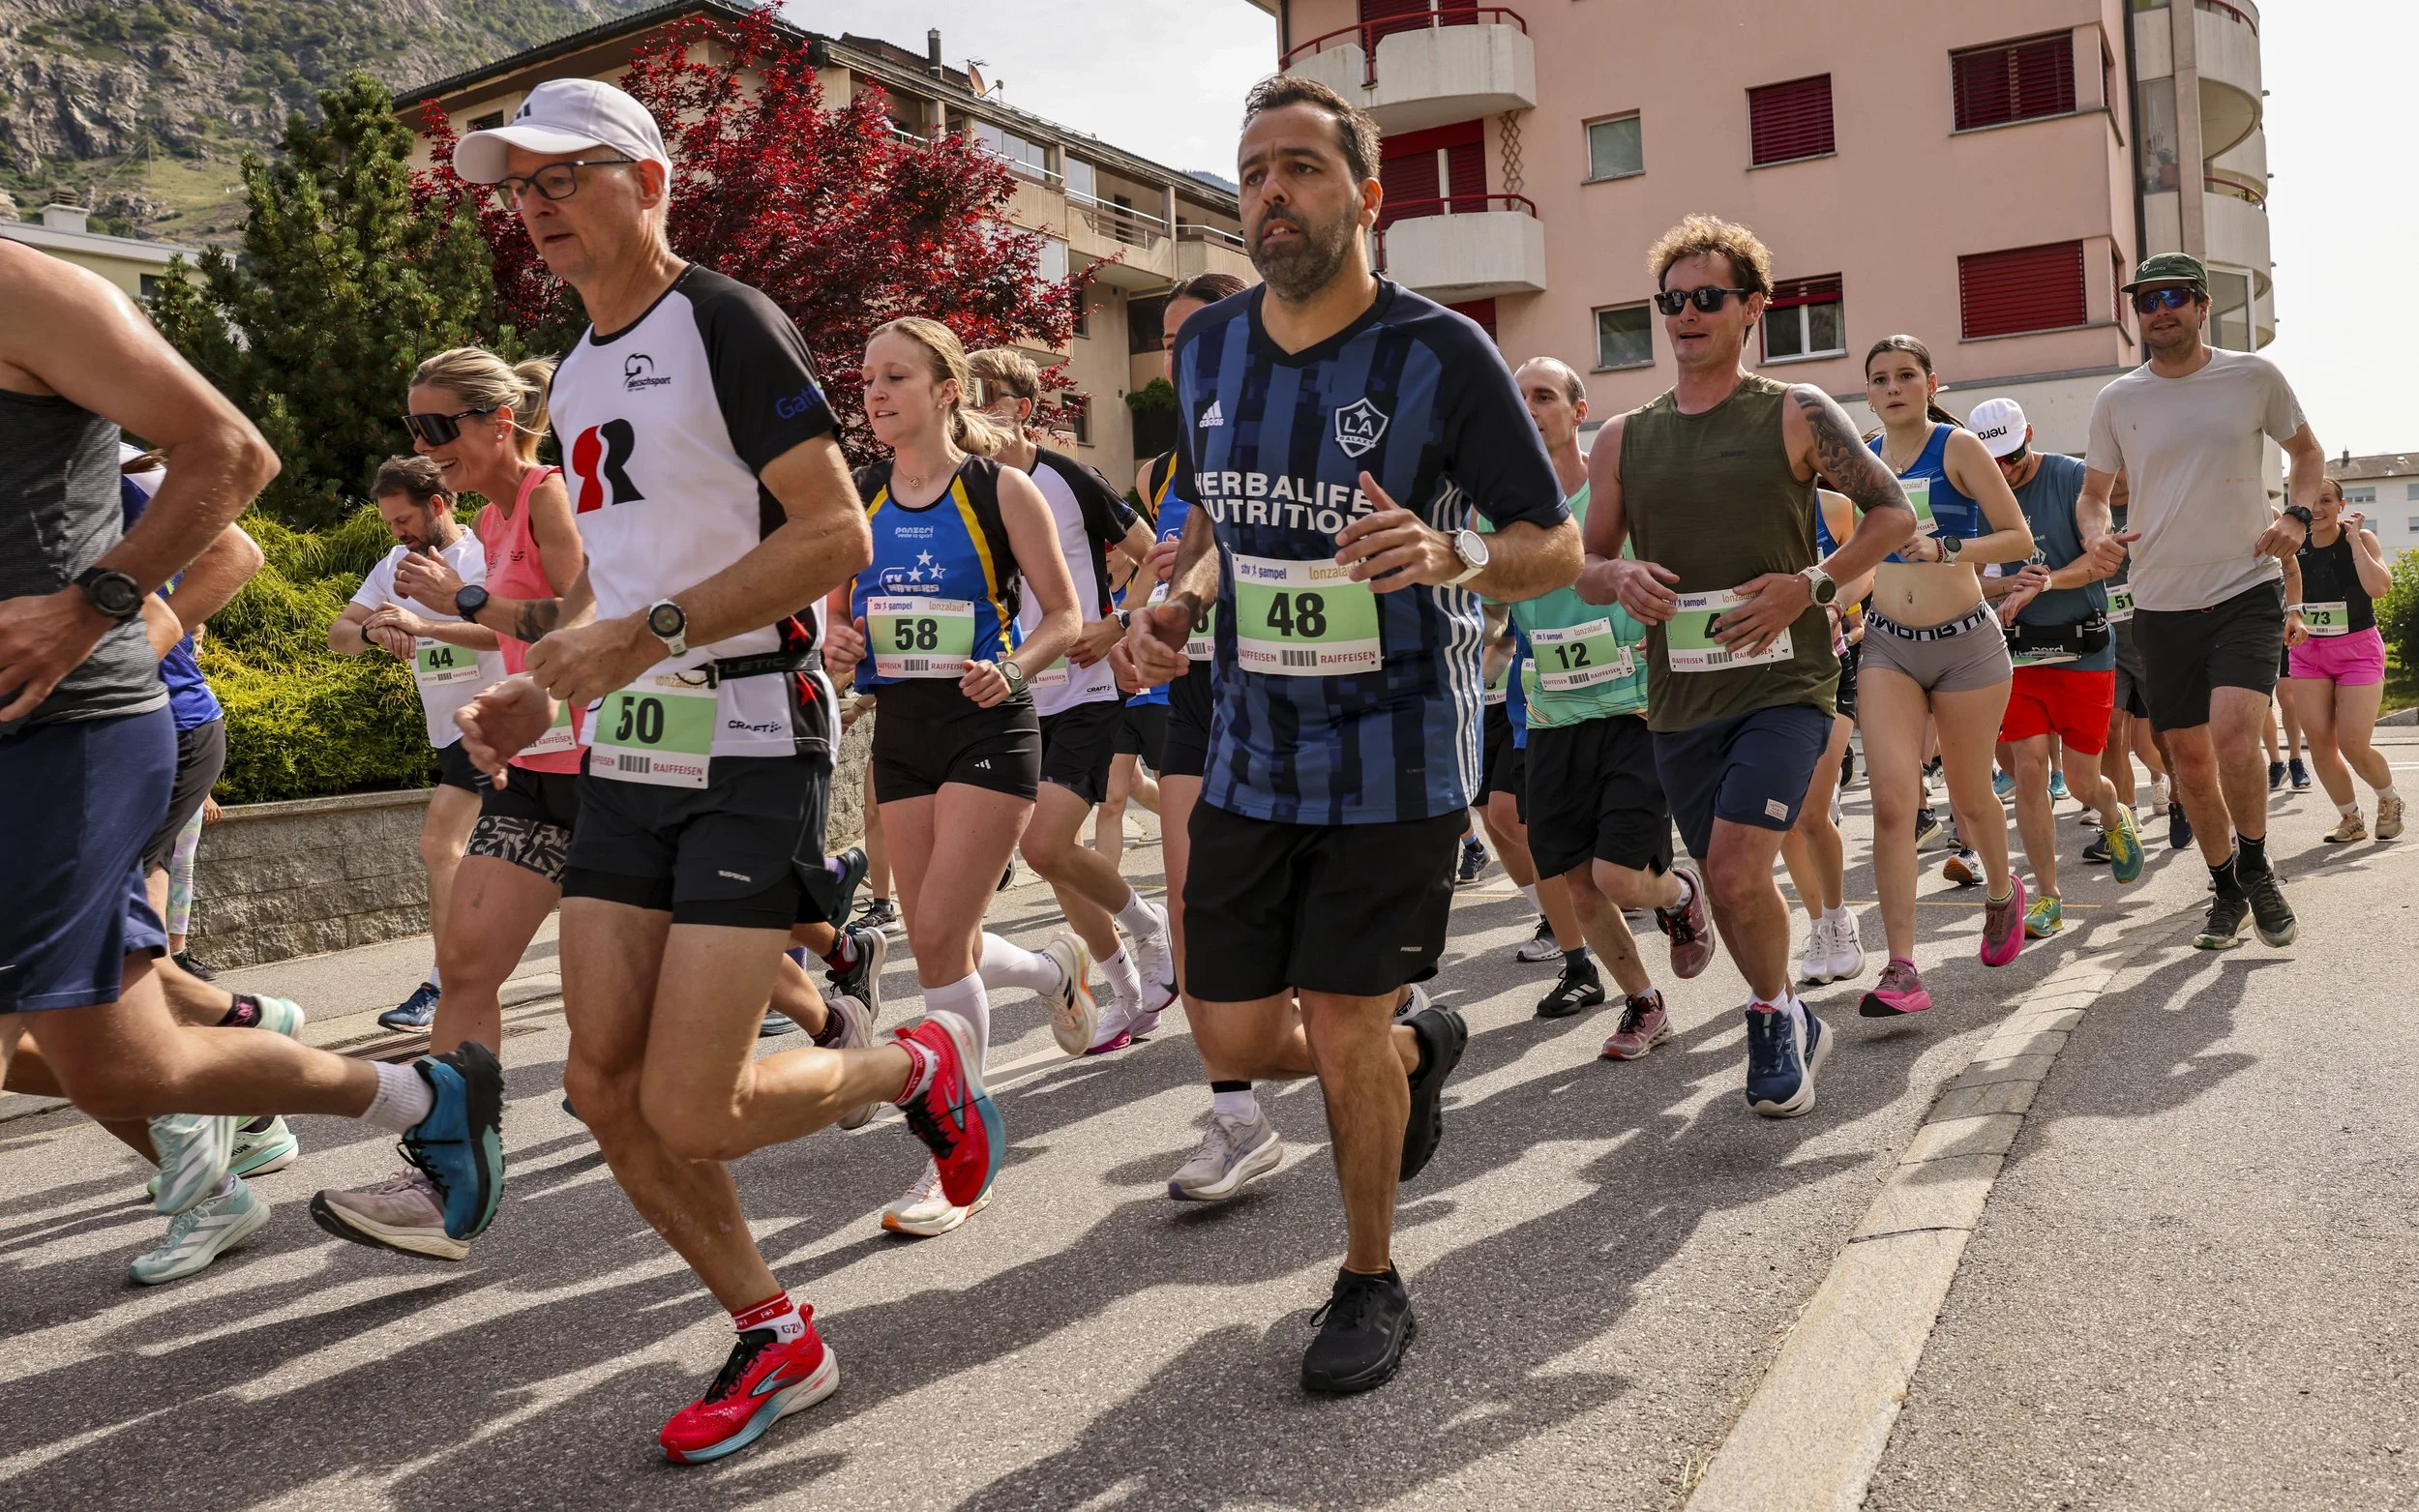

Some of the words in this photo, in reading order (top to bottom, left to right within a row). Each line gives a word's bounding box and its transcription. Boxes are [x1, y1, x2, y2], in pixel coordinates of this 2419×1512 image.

[1199, 418, 1224, 428] adidas
[1343, 416, 1374, 437] LA
[1338, 435, 1375, 448] GALAXY
[1194, 471, 1374, 514] HERBALIFE
[895, 526, 934, 535] panzeri
[885, 574, 903, 583] TV
[1241, 564, 1251, 575] stv
[1258, 567, 1287, 580] gampel
[888, 601, 912, 611] gampel
[929, 601, 965, 612] lonzalauf
[1683, 596, 1707, 608] gampel
[2114, 592, 2135, 609] 51
[1267, 592, 1327, 638] 48
[2310, 611, 2331, 625] 73
[895, 618, 938, 650] 58
[1546, 632, 1563, 641] gampel
[1574, 623, 1602, 637] lonzalauf
[430, 648, 454, 668] 44
[1239, 648, 1277, 663] RAIFFEISEN
[1321, 651, 1376, 665] RAIFFEISEN
[1555, 642, 1591, 669] 12
[1735, 647, 1774, 660] RAIFSEN
[1590, 667, 1622, 680] RAIFFEISEN
[1087, 685, 1107, 694] CRAFT
[615, 697, 664, 744] 50
[728, 720, 769, 732] CRAFT
[538, 734, 572, 746] RAIFFEISEN
[653, 762, 703, 776] RAIFFEISEN
